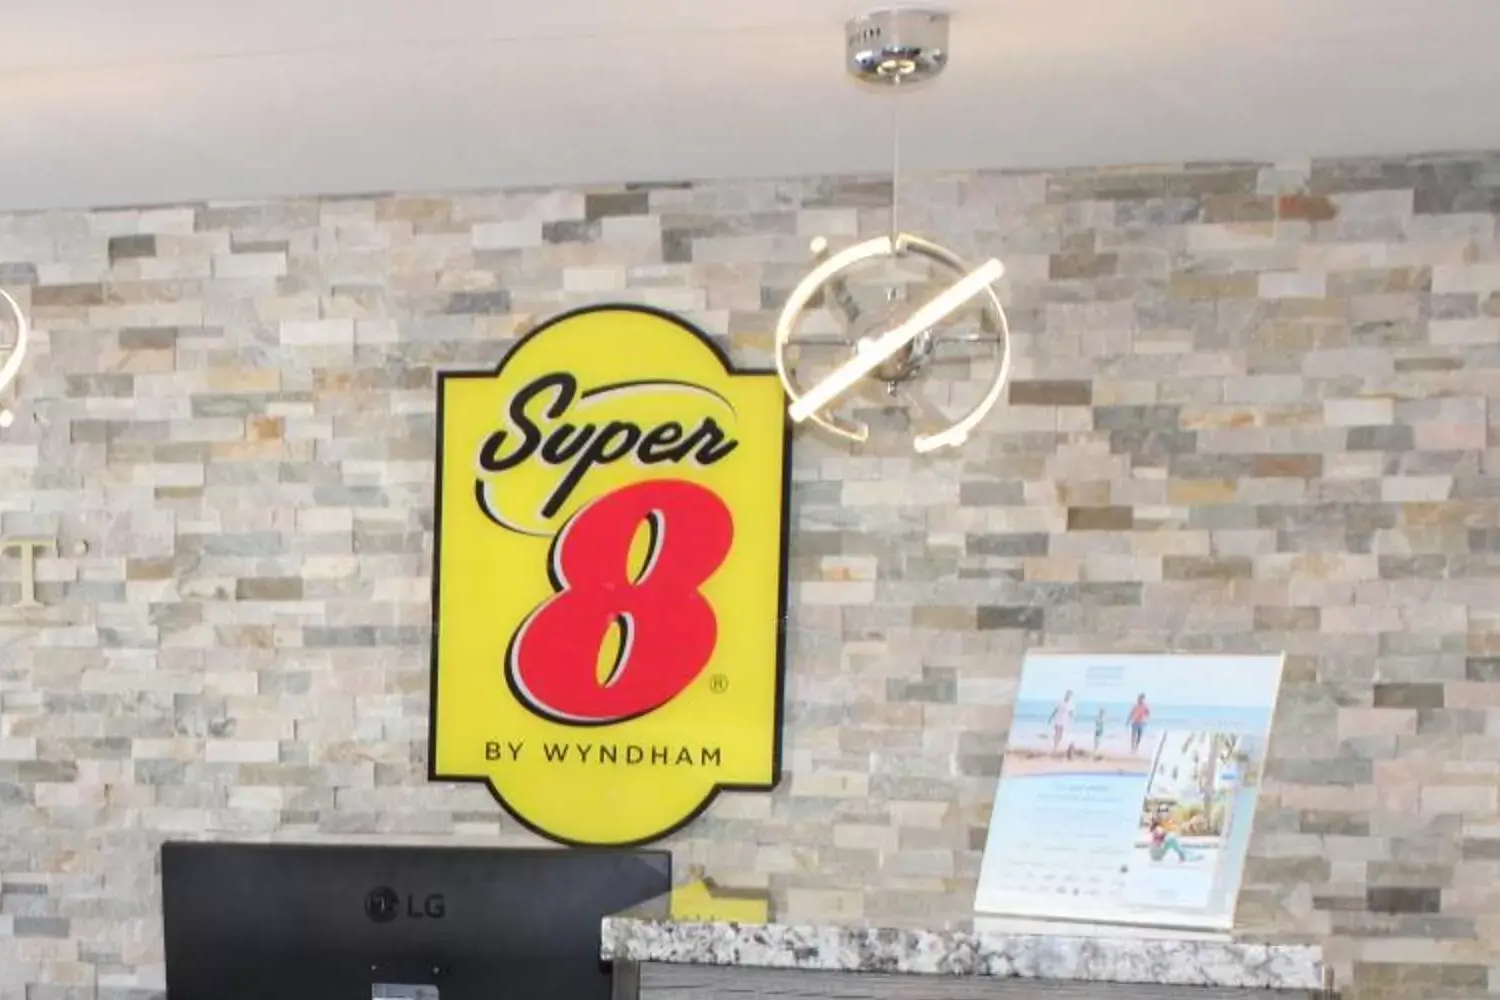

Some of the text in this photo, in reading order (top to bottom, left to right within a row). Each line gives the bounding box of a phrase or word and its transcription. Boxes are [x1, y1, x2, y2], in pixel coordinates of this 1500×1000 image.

[479, 371, 739, 519] Super
[503, 477, 735, 728] 8
[484, 741, 722, 767] BY WYNDHAM
[406, 892, 447, 919] LG
